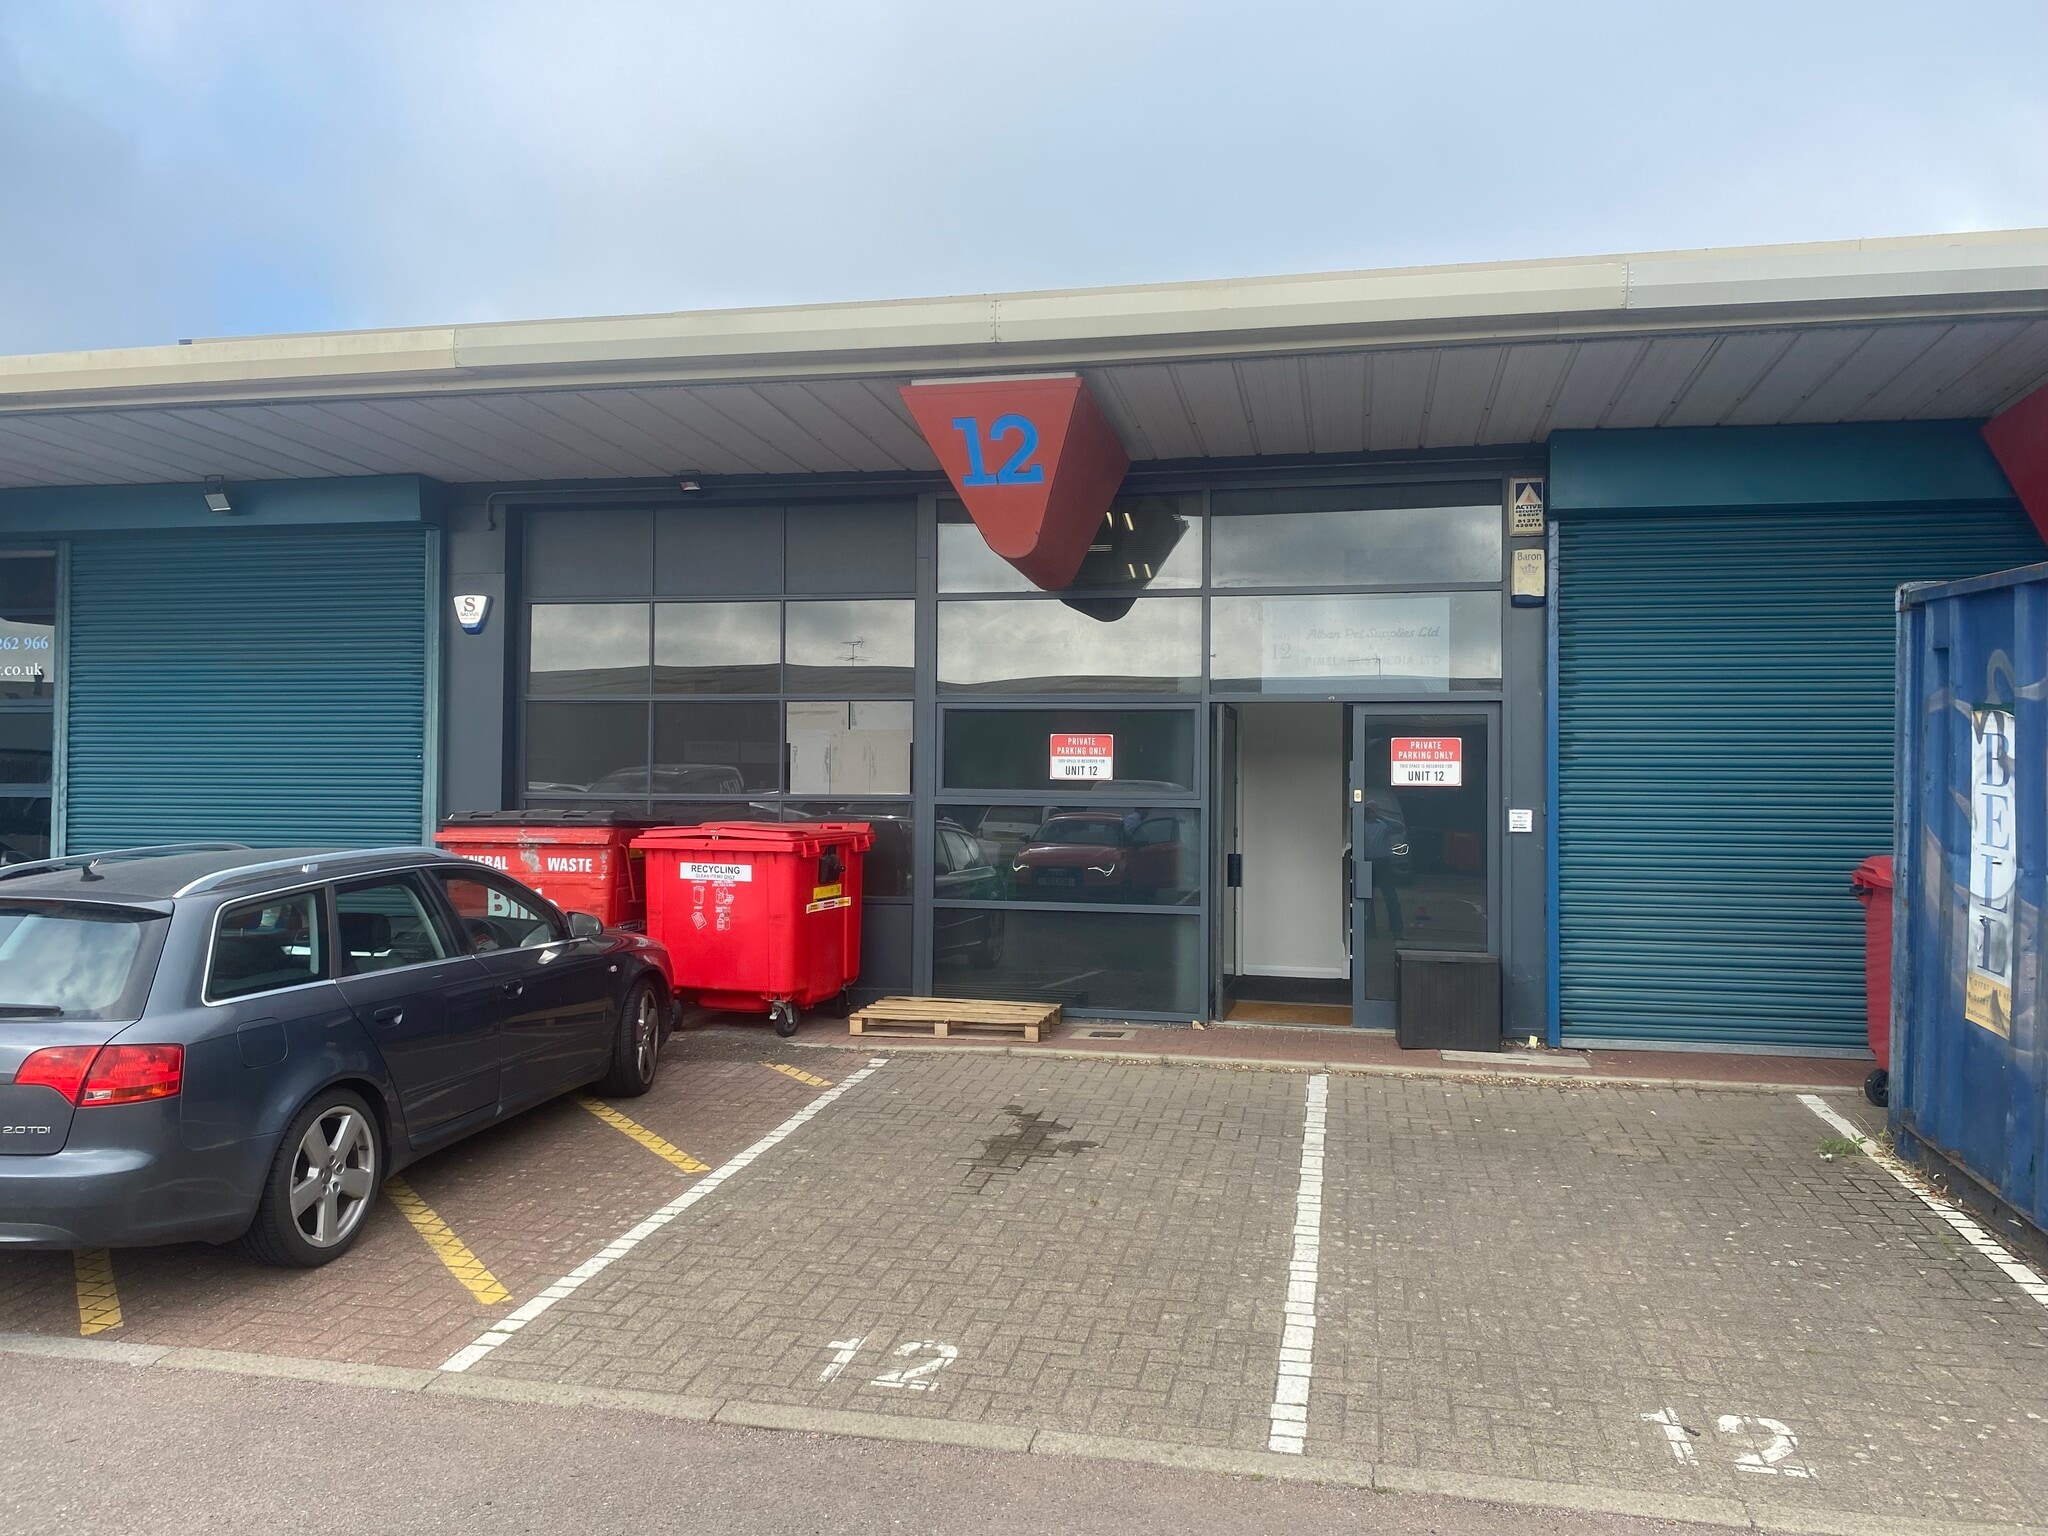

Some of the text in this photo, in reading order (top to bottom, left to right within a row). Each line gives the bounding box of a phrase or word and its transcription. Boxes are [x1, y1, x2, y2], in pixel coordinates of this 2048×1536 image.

[952, 414, 1044, 487] 12
[1517, 552, 1542, 561] Baron
[464, 597, 476, 612] S
[1304, 629, 1341, 640] Alban
[1367, 627, 1415, 641] Supplies
[1418, 626, 1441, 637] Ltd
[0, 635, 49, 650] 62 966
[1270, 642, 1292, 660] 12
[0, 663, 43, 676] .co.uk
[1067, 737, 1096, 746] PRIVATE
[1410, 741, 1442, 750] PRIVATE
[1056, 746, 1107, 755] PARKING ONLY
[1398, 751, 1454, 760] PARKING ONLY
[1065, 766, 1098, 775] UNIT 12
[1408, 771, 1444, 781] UNIT 12
[1977, 732, 2010, 978] BELL
[547, 857, 593, 873] WASTE
[691, 865, 741, 875] RECYCLING
[2, 1126, 51, 1134] 2.0 TDI
[817, 1336, 958, 1391] 12
[1640, 1407, 1818, 1479] 12
